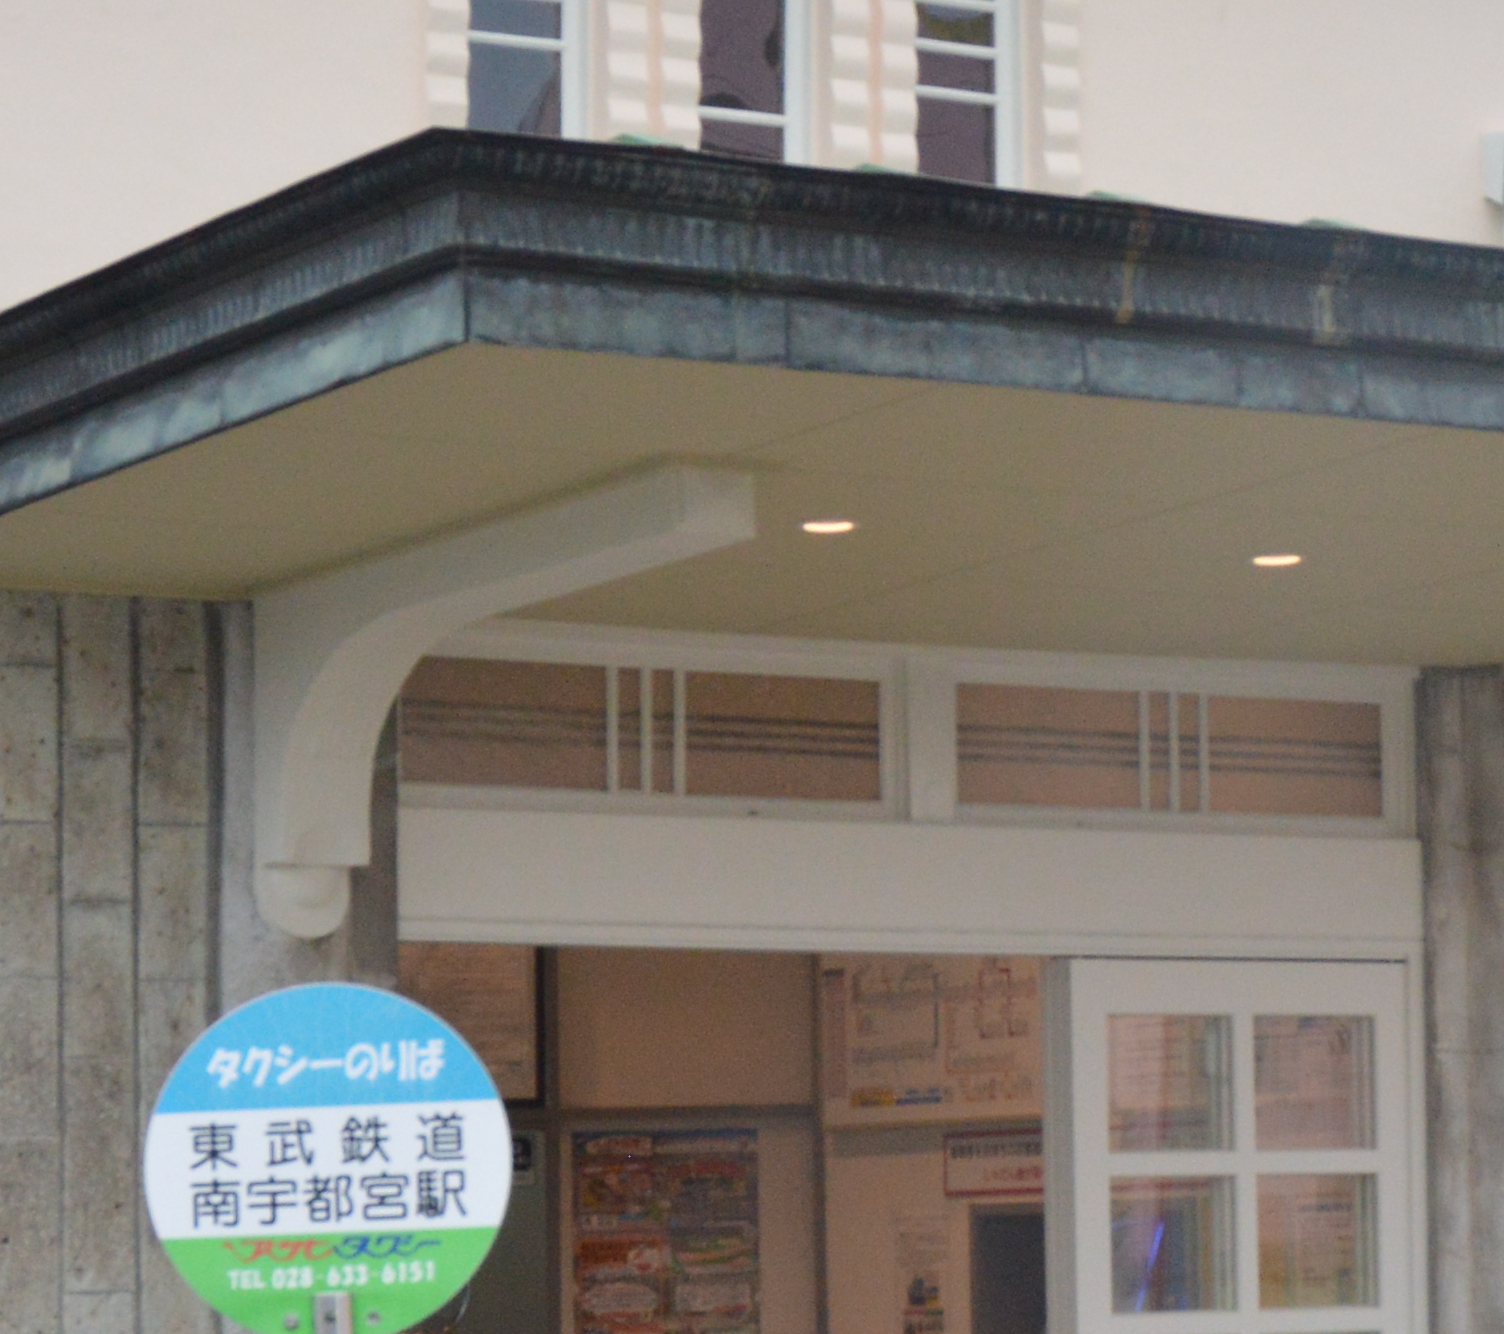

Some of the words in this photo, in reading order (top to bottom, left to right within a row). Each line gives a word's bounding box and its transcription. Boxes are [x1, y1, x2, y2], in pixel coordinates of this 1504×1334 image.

[207, 1039, 446, 1088] タクシーのりば
[188, 1112, 466, 1171] 東武鉄道
[190, 1169, 467, 1229] 南宇都宮駅
[227, 1268, 266, 1290] TEL
